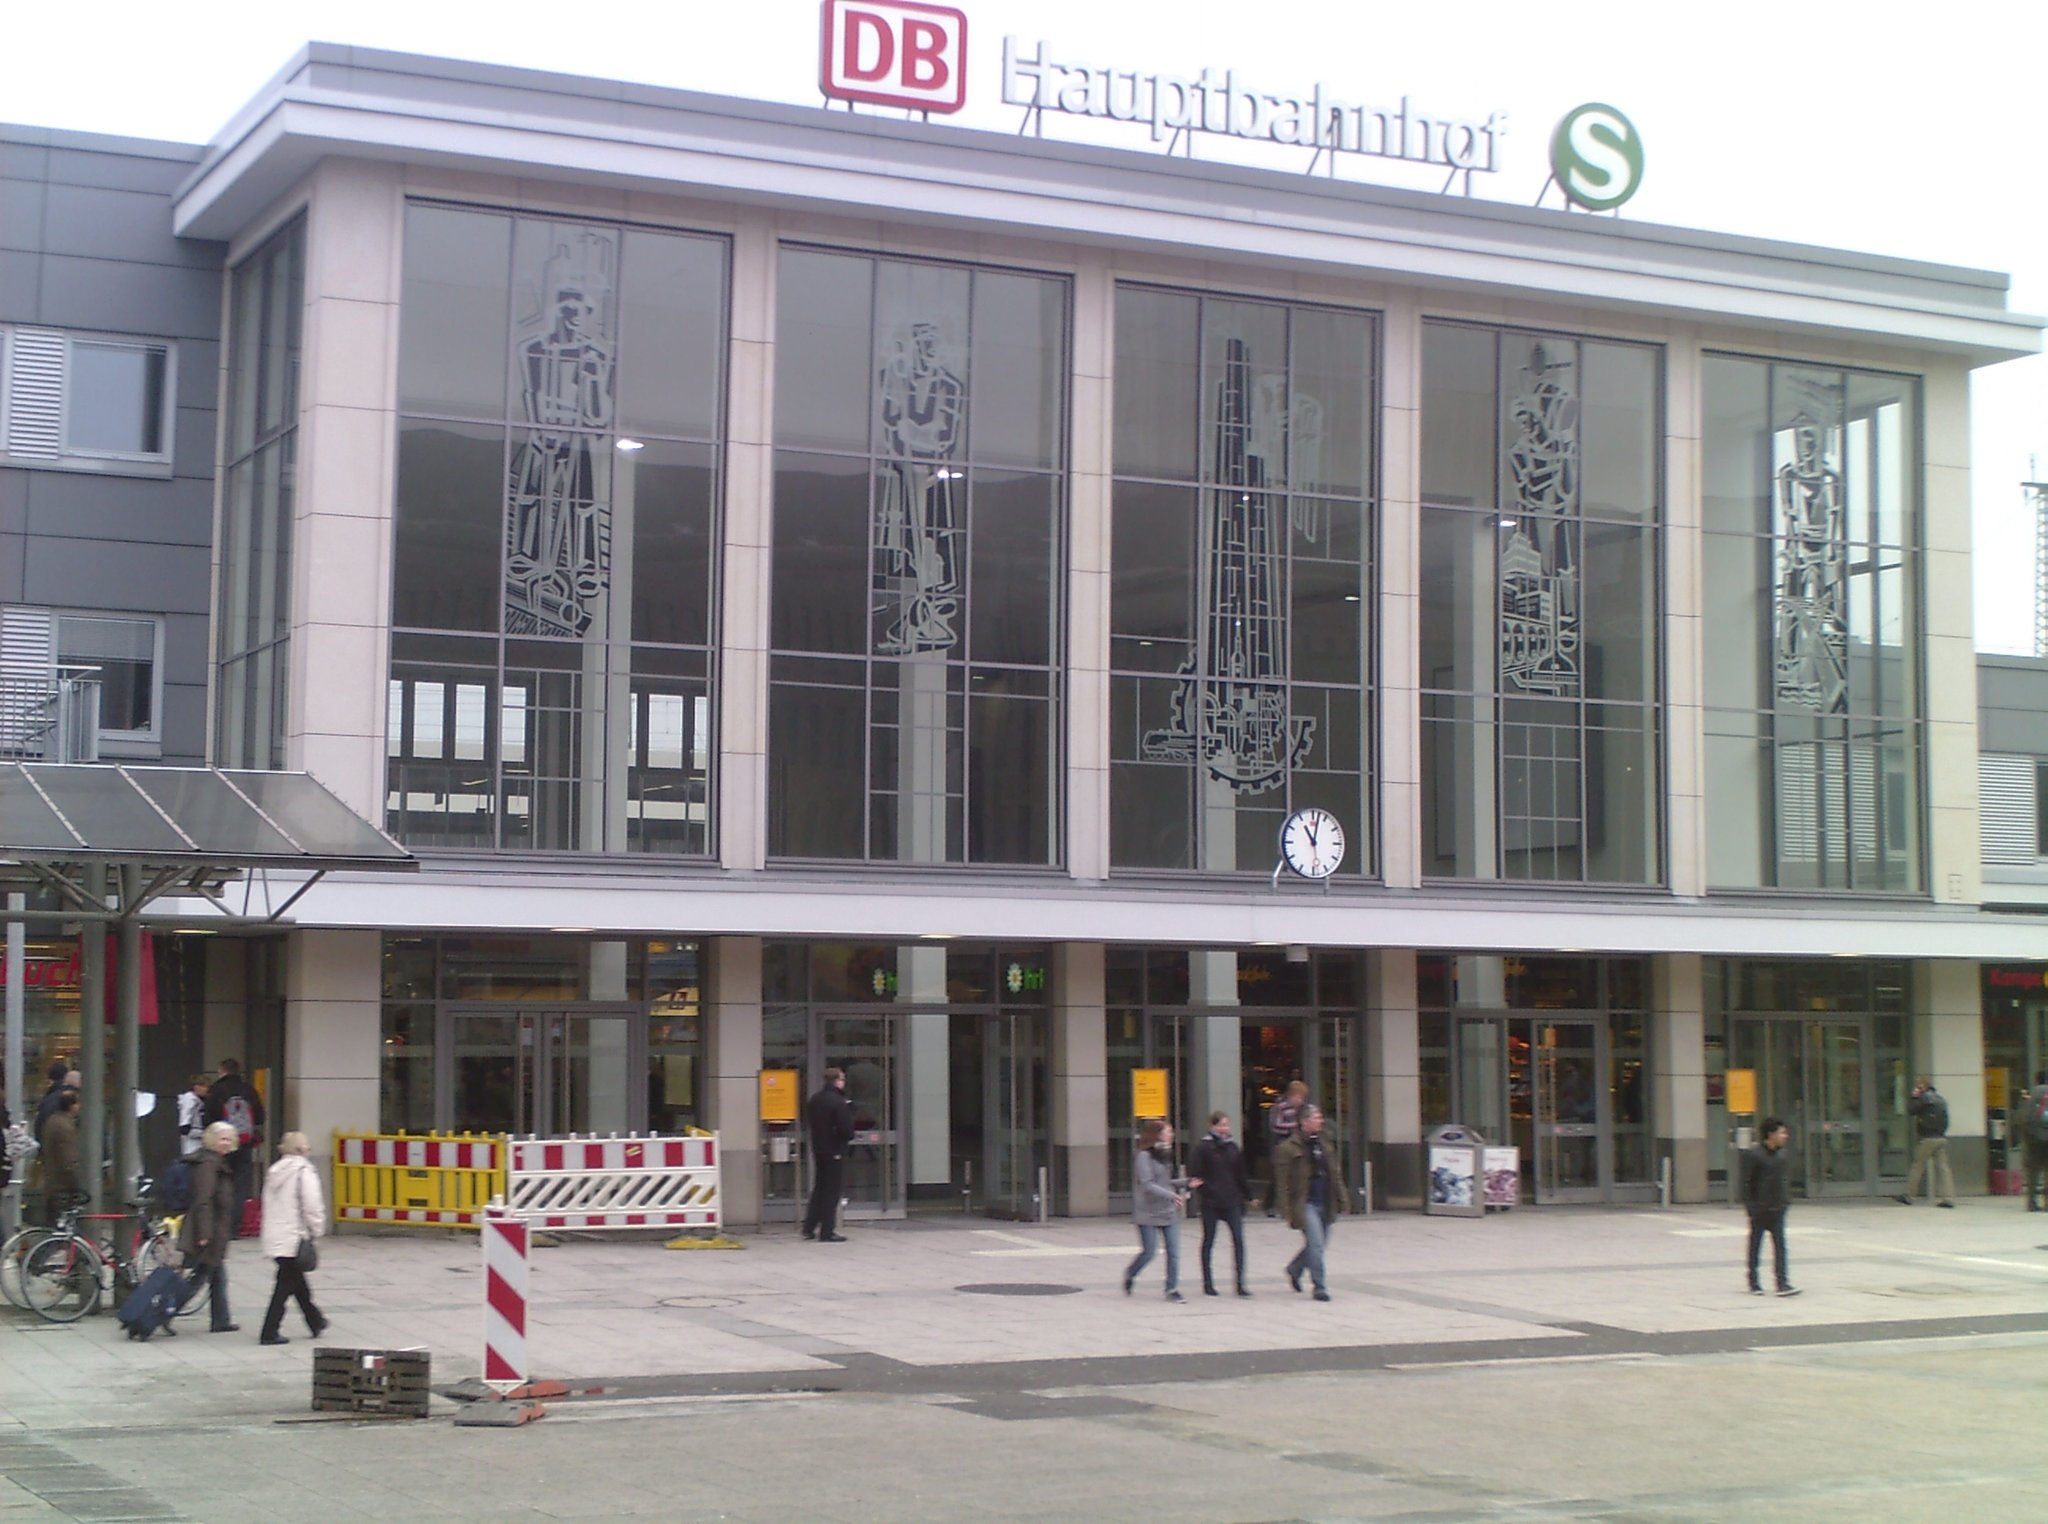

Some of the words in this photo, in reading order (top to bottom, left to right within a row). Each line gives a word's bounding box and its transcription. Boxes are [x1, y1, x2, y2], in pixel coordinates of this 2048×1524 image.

[844, 9, 949, 91] DB
[1001, 35, 1507, 173] Hauptbahnhof
[1569, 111, 1631, 201] S
